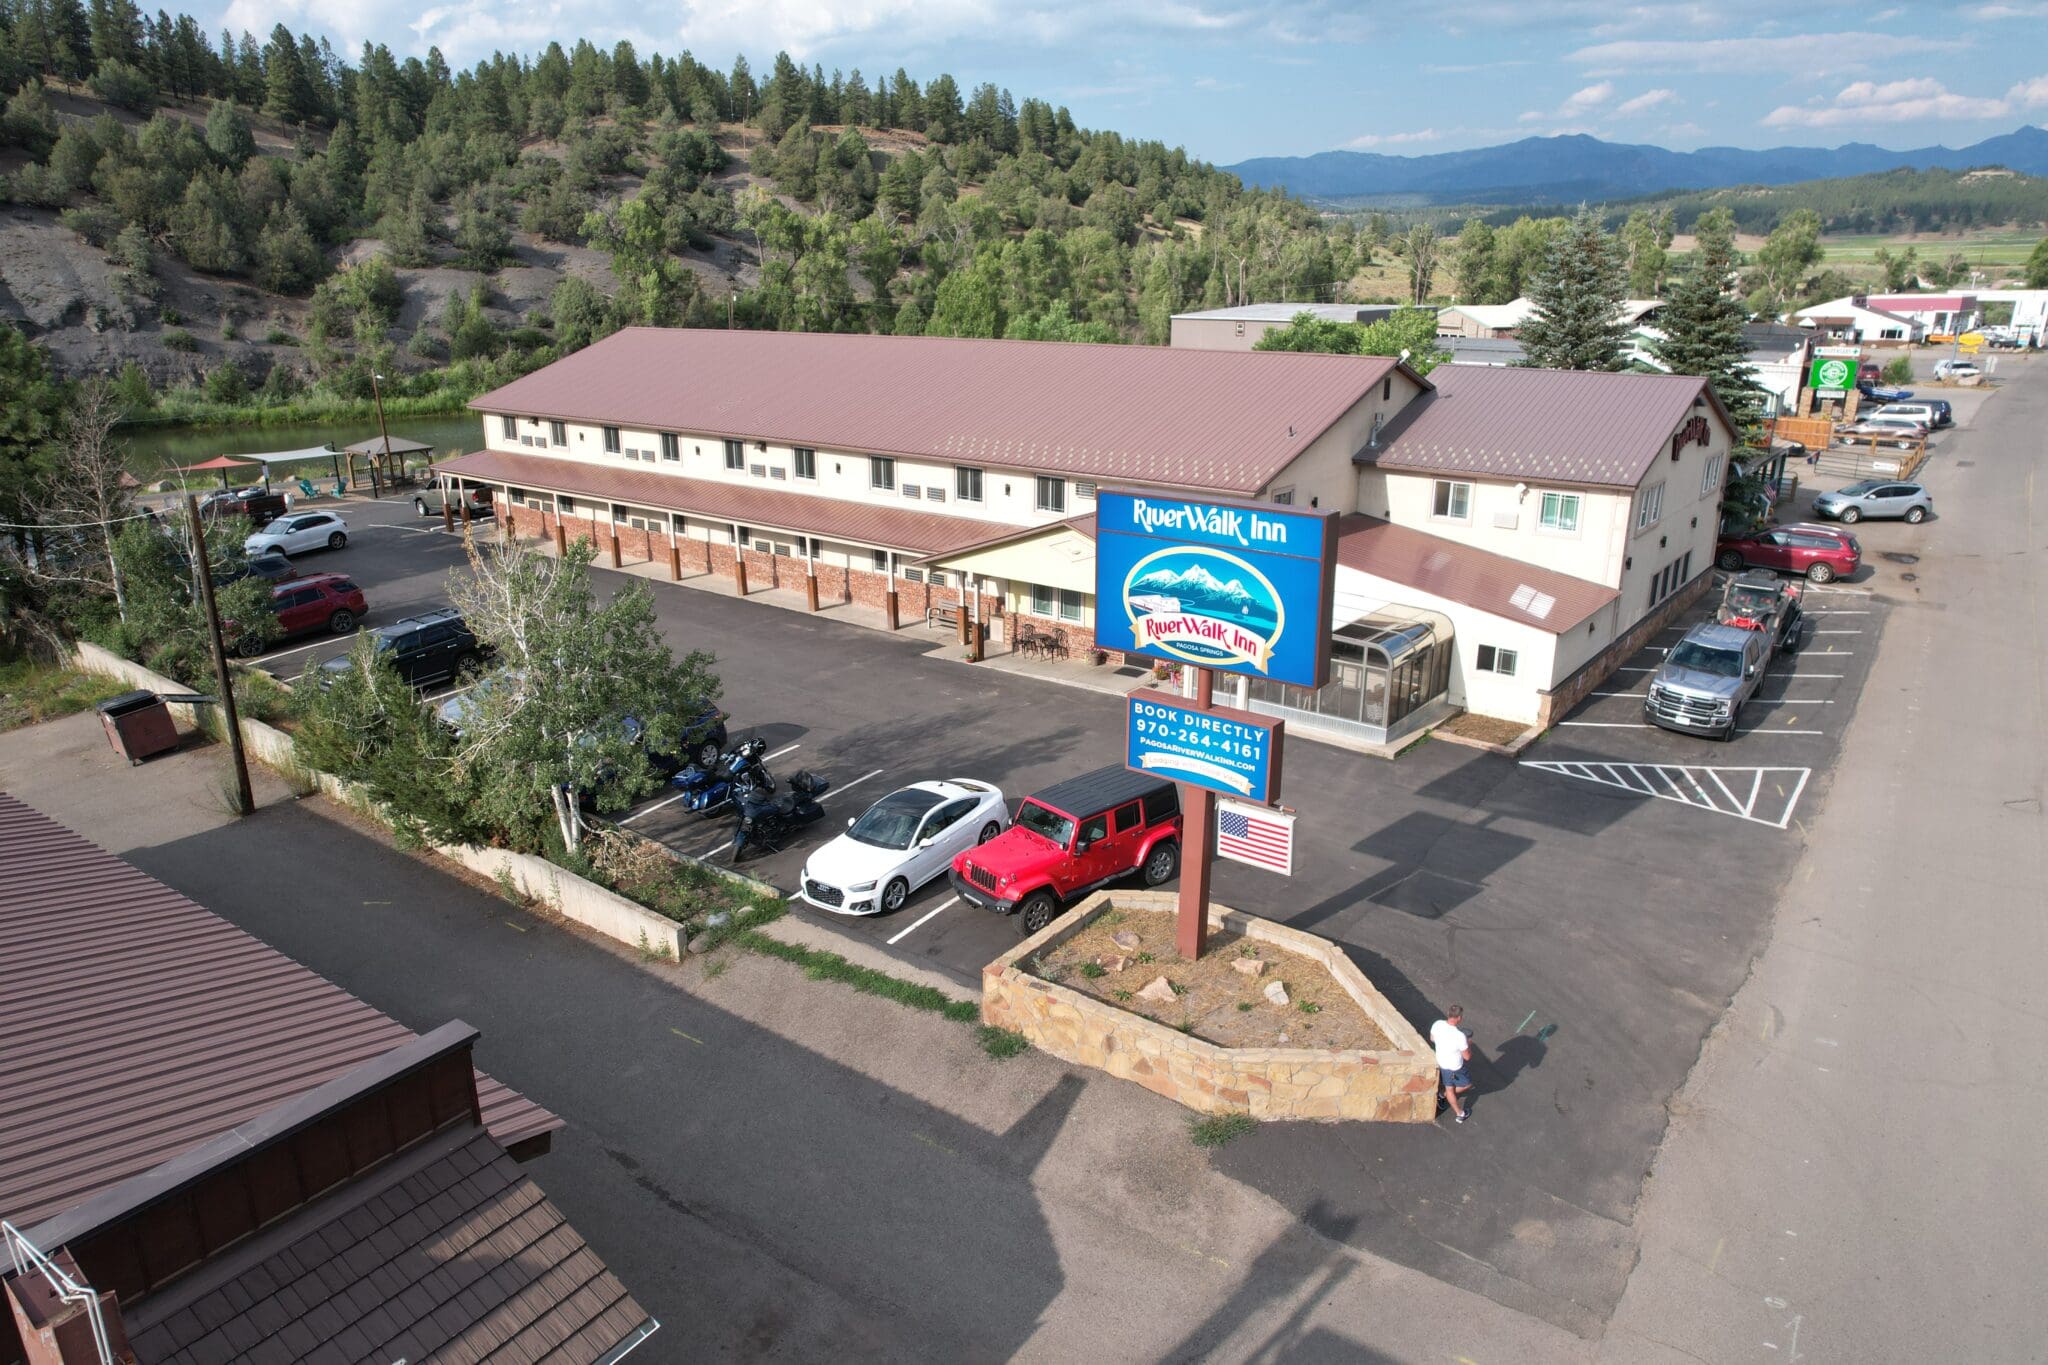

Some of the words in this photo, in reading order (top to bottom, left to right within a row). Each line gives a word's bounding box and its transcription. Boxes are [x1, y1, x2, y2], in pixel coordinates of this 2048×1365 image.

[1133, 499, 1249, 546] RiverWalk
[1250, 514, 1287, 543] Inn
[1146, 617, 1231, 649] RiverWalk
[1233, 629, 1257, 656] Inn
[1176, 642, 1199, 651] PAGOSA
[1199, 646, 1224, 657] SPRINGS
[1134, 702, 1177, 722] BOOK
[1184, 713, 1264, 742] DIRECTLY
[1136, 719, 1261, 760] 970-264-4161
